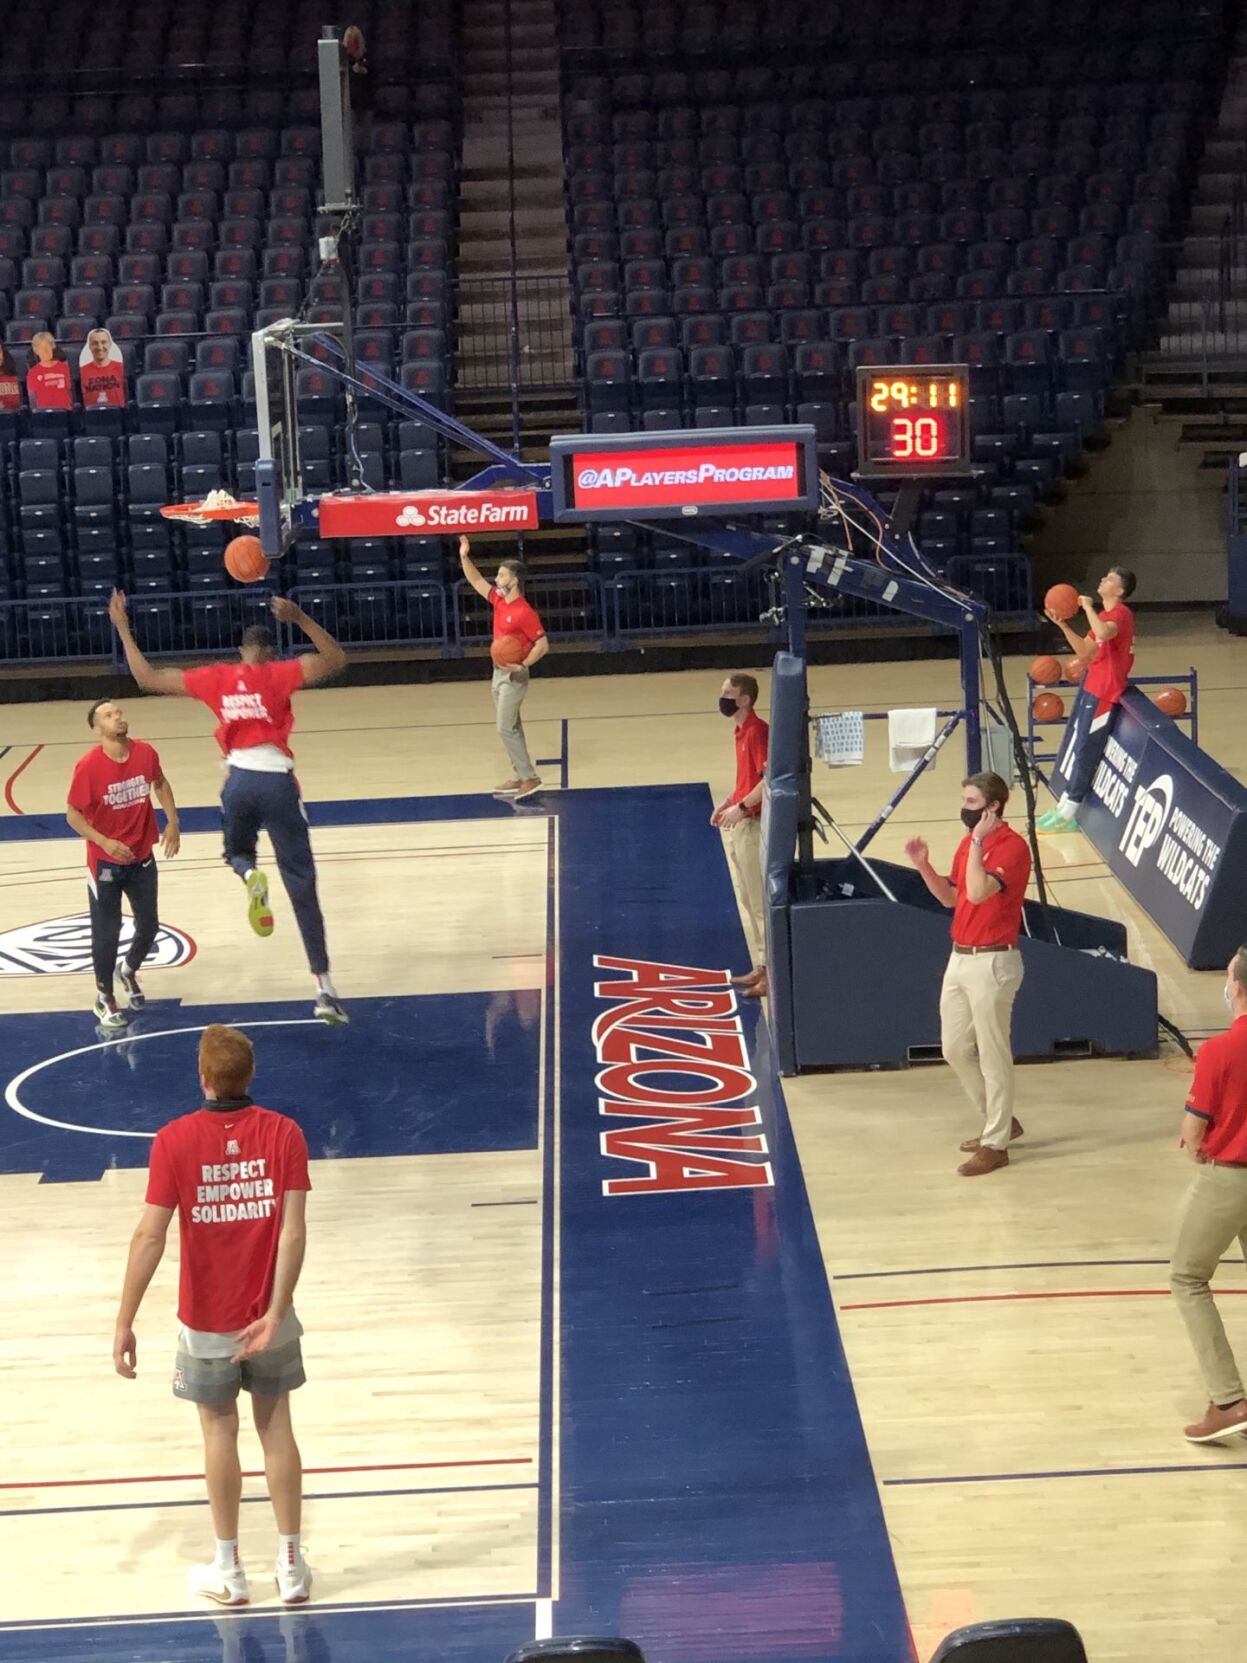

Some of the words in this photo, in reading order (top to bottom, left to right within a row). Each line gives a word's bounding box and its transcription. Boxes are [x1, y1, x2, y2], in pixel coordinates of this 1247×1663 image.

[871, 382, 957, 412] 29:11
[893, 418, 938, 457] 30
[107, 774, 145, 794] STRONGER
[1122, 755, 1138, 784] THE
[1119, 784, 1164, 868] TEP
[1168, 806, 1207, 857] POWERING
[1201, 838, 1221, 871] THE
[1156, 833, 1210, 910] WILDCATS
[591, 954, 775, 1196] ARIZONA
[202, 1159, 266, 1183] RESPECT
[197, 1179, 274, 1203] EMPOWER
